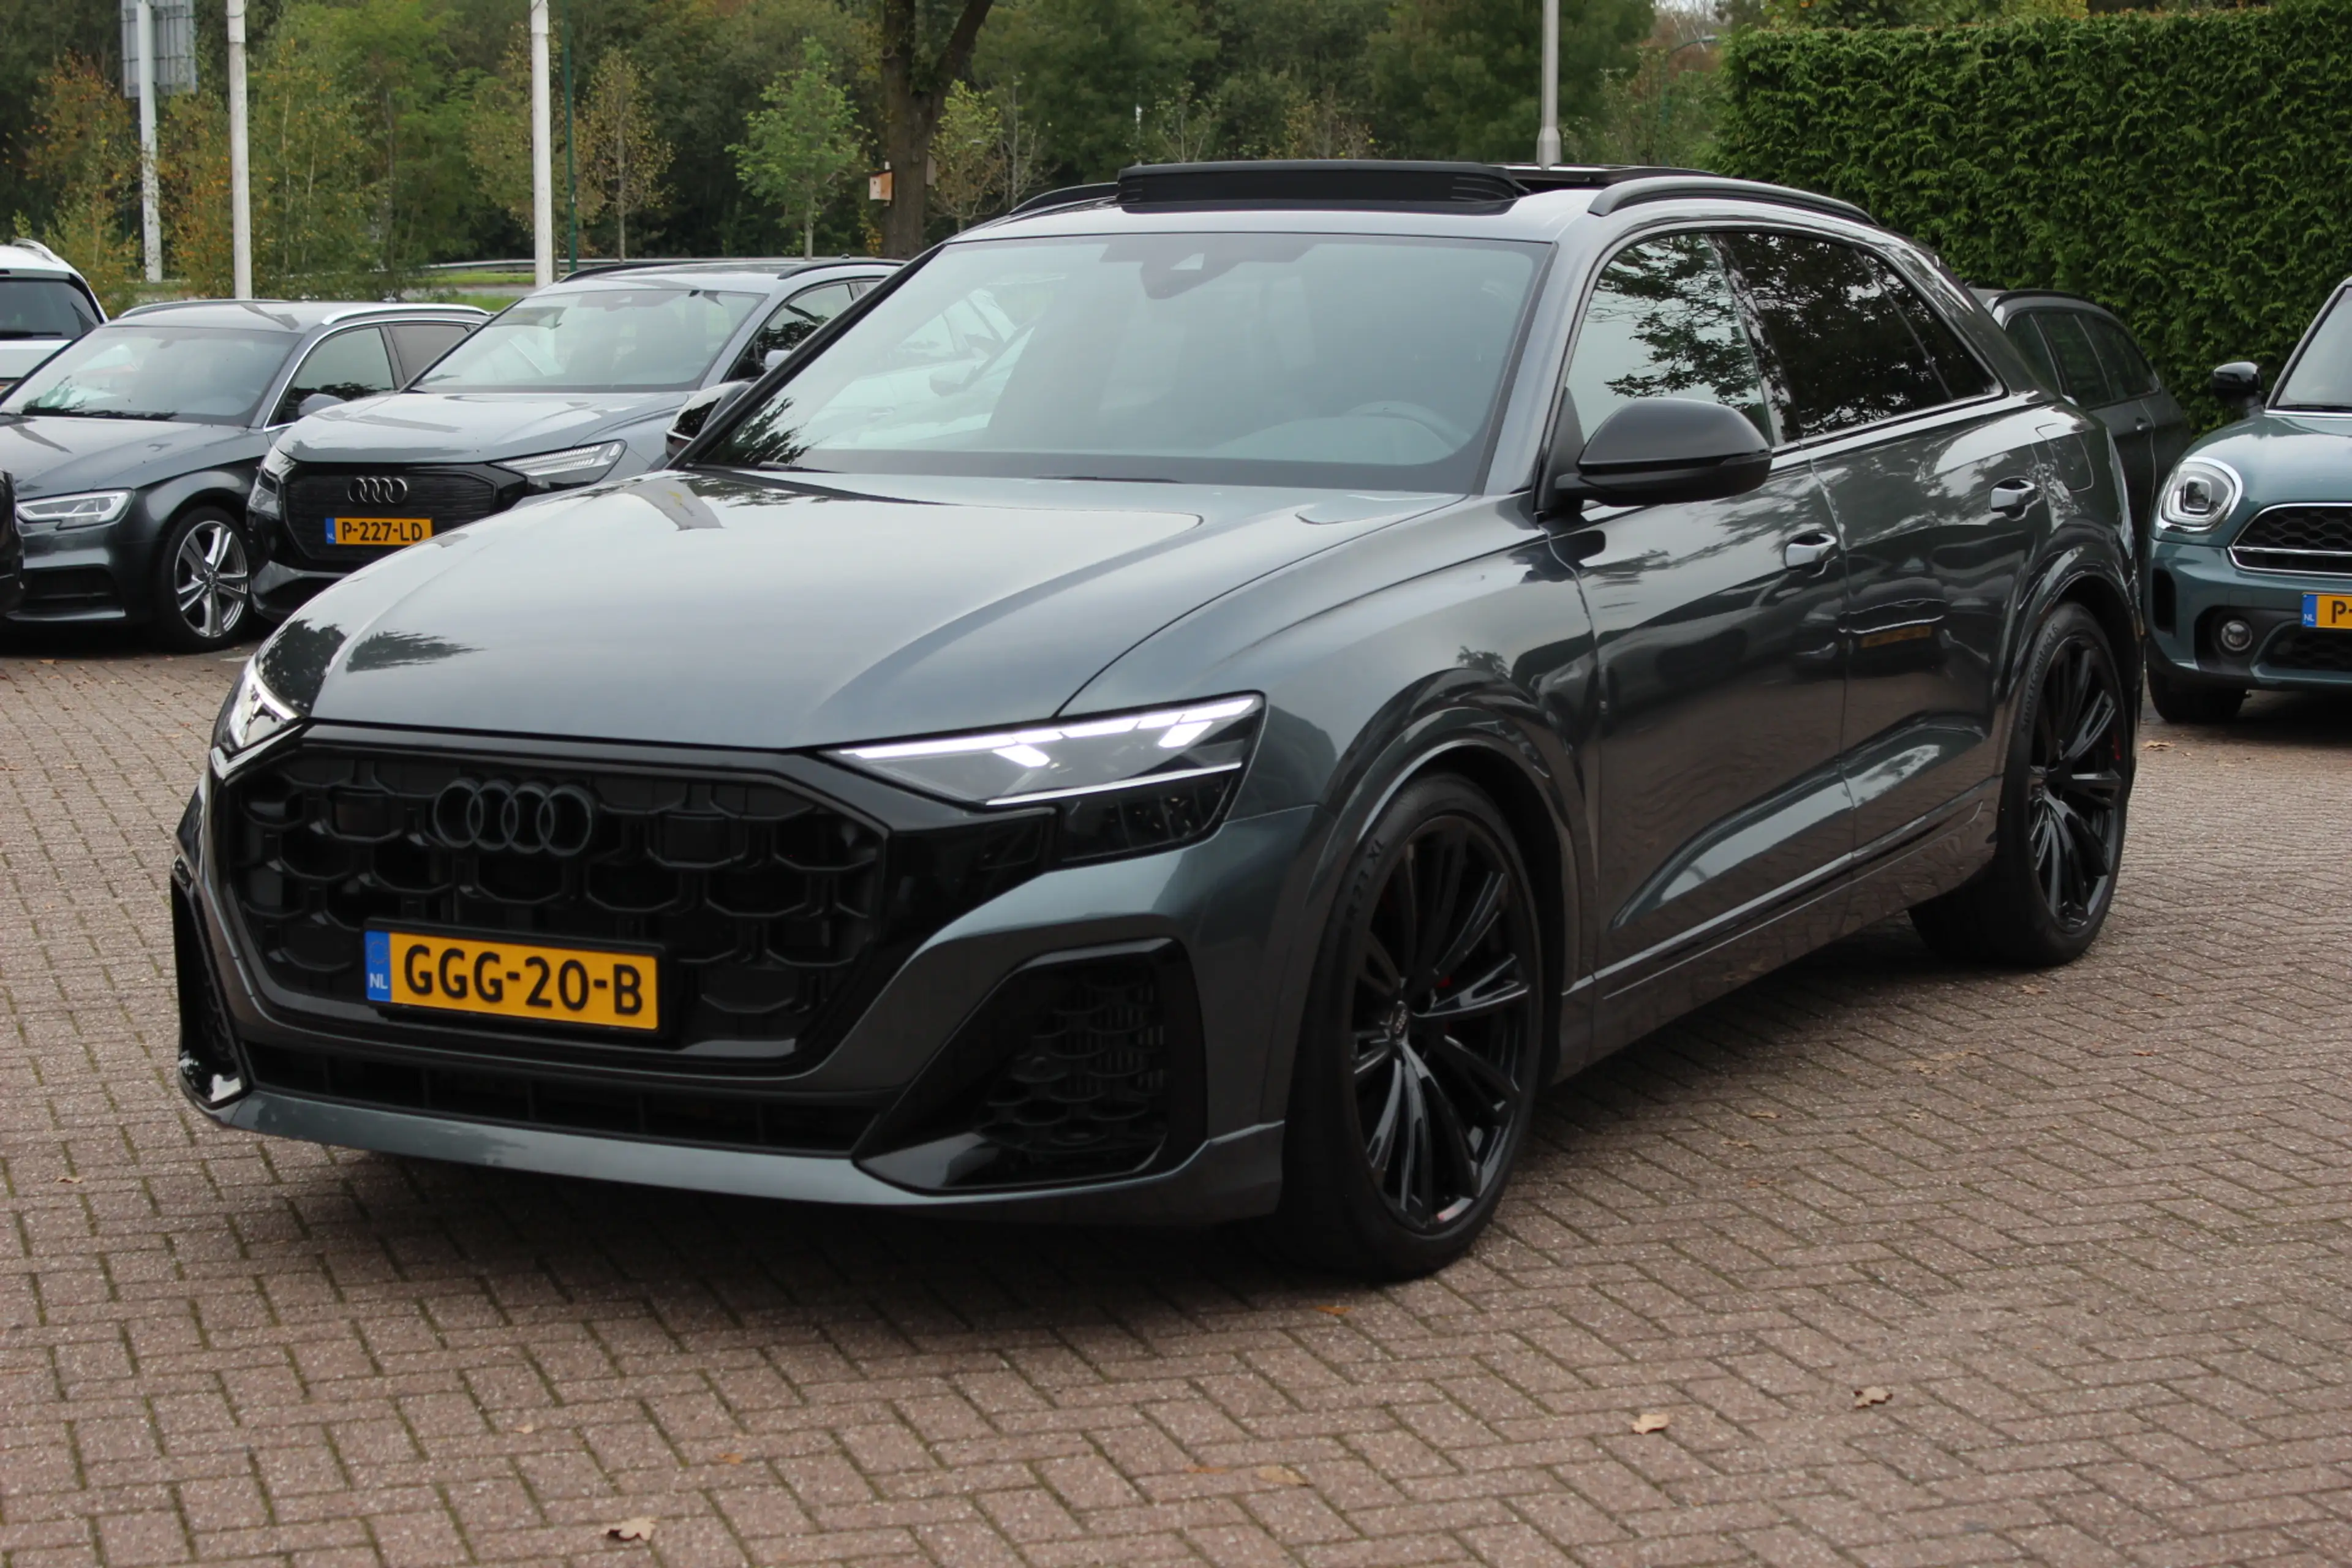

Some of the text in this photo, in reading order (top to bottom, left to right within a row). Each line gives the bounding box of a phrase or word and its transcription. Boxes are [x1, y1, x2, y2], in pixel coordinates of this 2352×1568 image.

[342, 522, 423, 541] P-227-LD
[369, 944, 643, 1016] NL GGG-20-B
